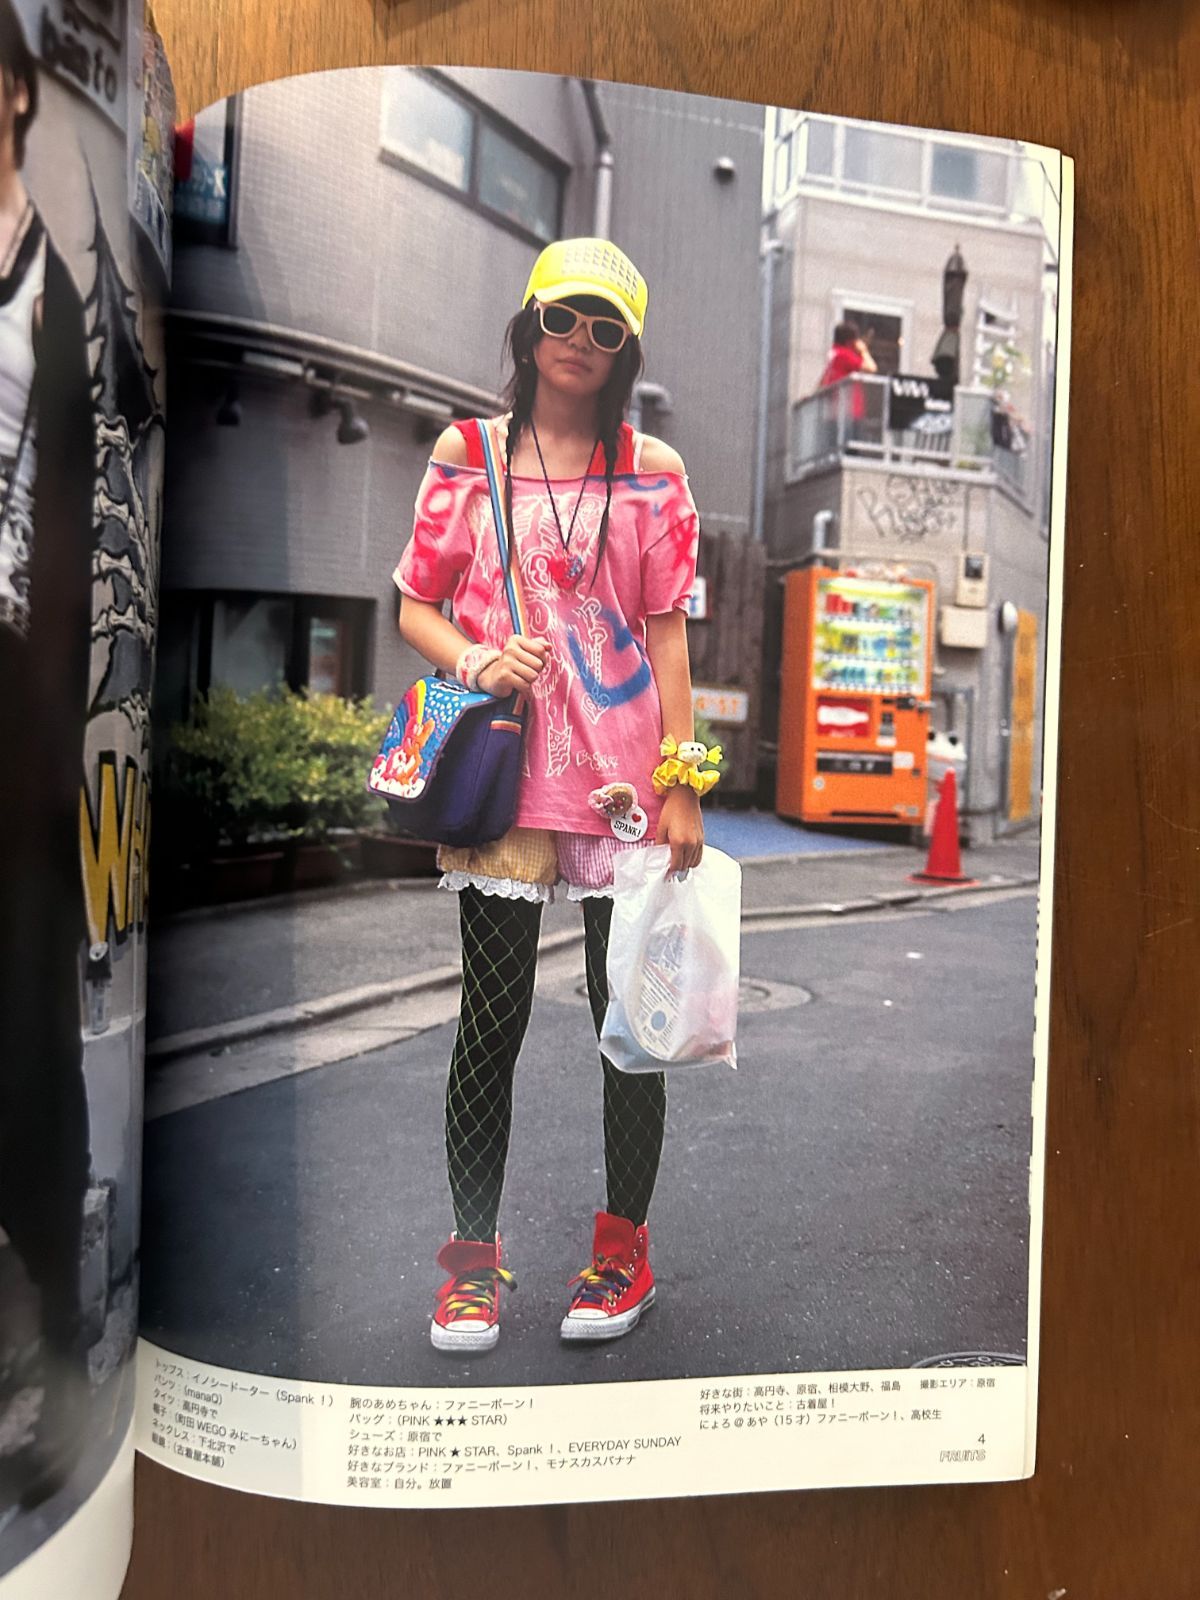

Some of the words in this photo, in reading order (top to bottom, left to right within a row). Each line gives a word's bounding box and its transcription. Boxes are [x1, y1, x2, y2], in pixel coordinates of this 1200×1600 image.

[613, 820, 641, 838] SPANK!
[568, 1439, 630, 1453] EVERYDAY
[634, 1436, 682, 1450] SUNDAY
[978, 1433, 986, 1444] 4
